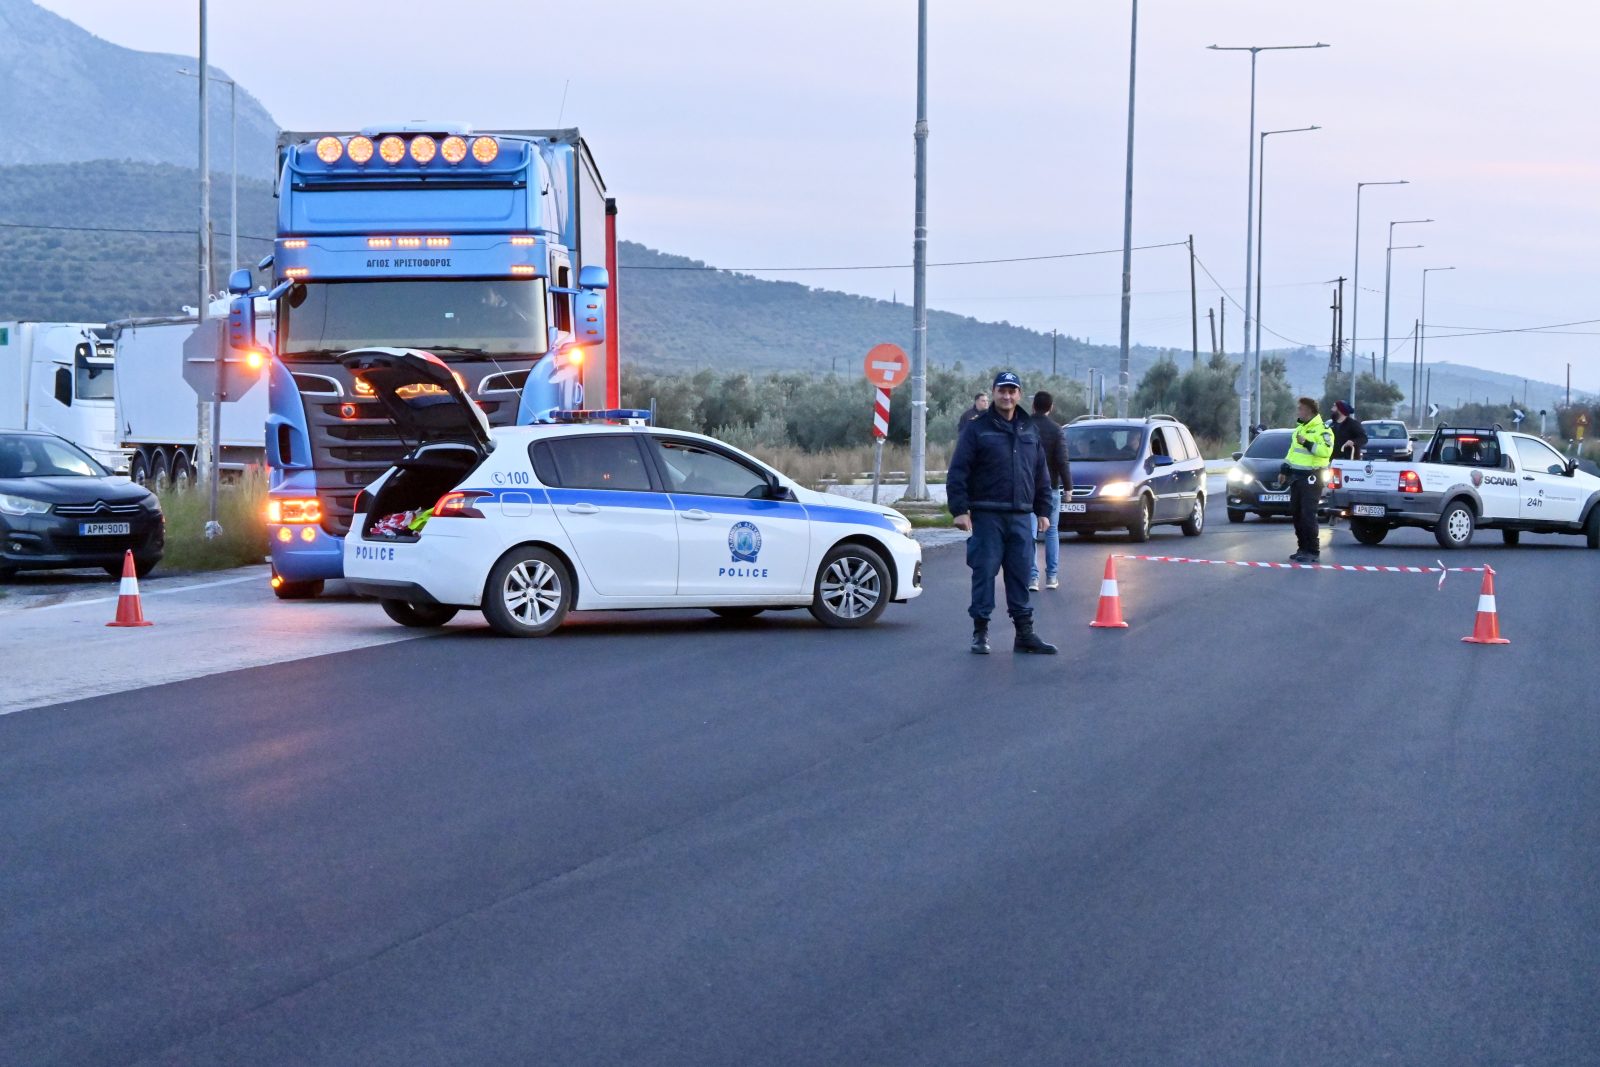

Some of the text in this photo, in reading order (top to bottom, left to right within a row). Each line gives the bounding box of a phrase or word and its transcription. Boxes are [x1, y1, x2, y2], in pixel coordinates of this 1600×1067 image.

[366, 259, 390, 268] ΑΓΙΟΣ
[507, 471, 529, 485] 100
[1484, 475, 1518, 487] SCANIA
[1527, 497, 1543, 508] 24h
[356, 545, 394, 561] POLICE
[718, 567, 768, 578] POLICE
